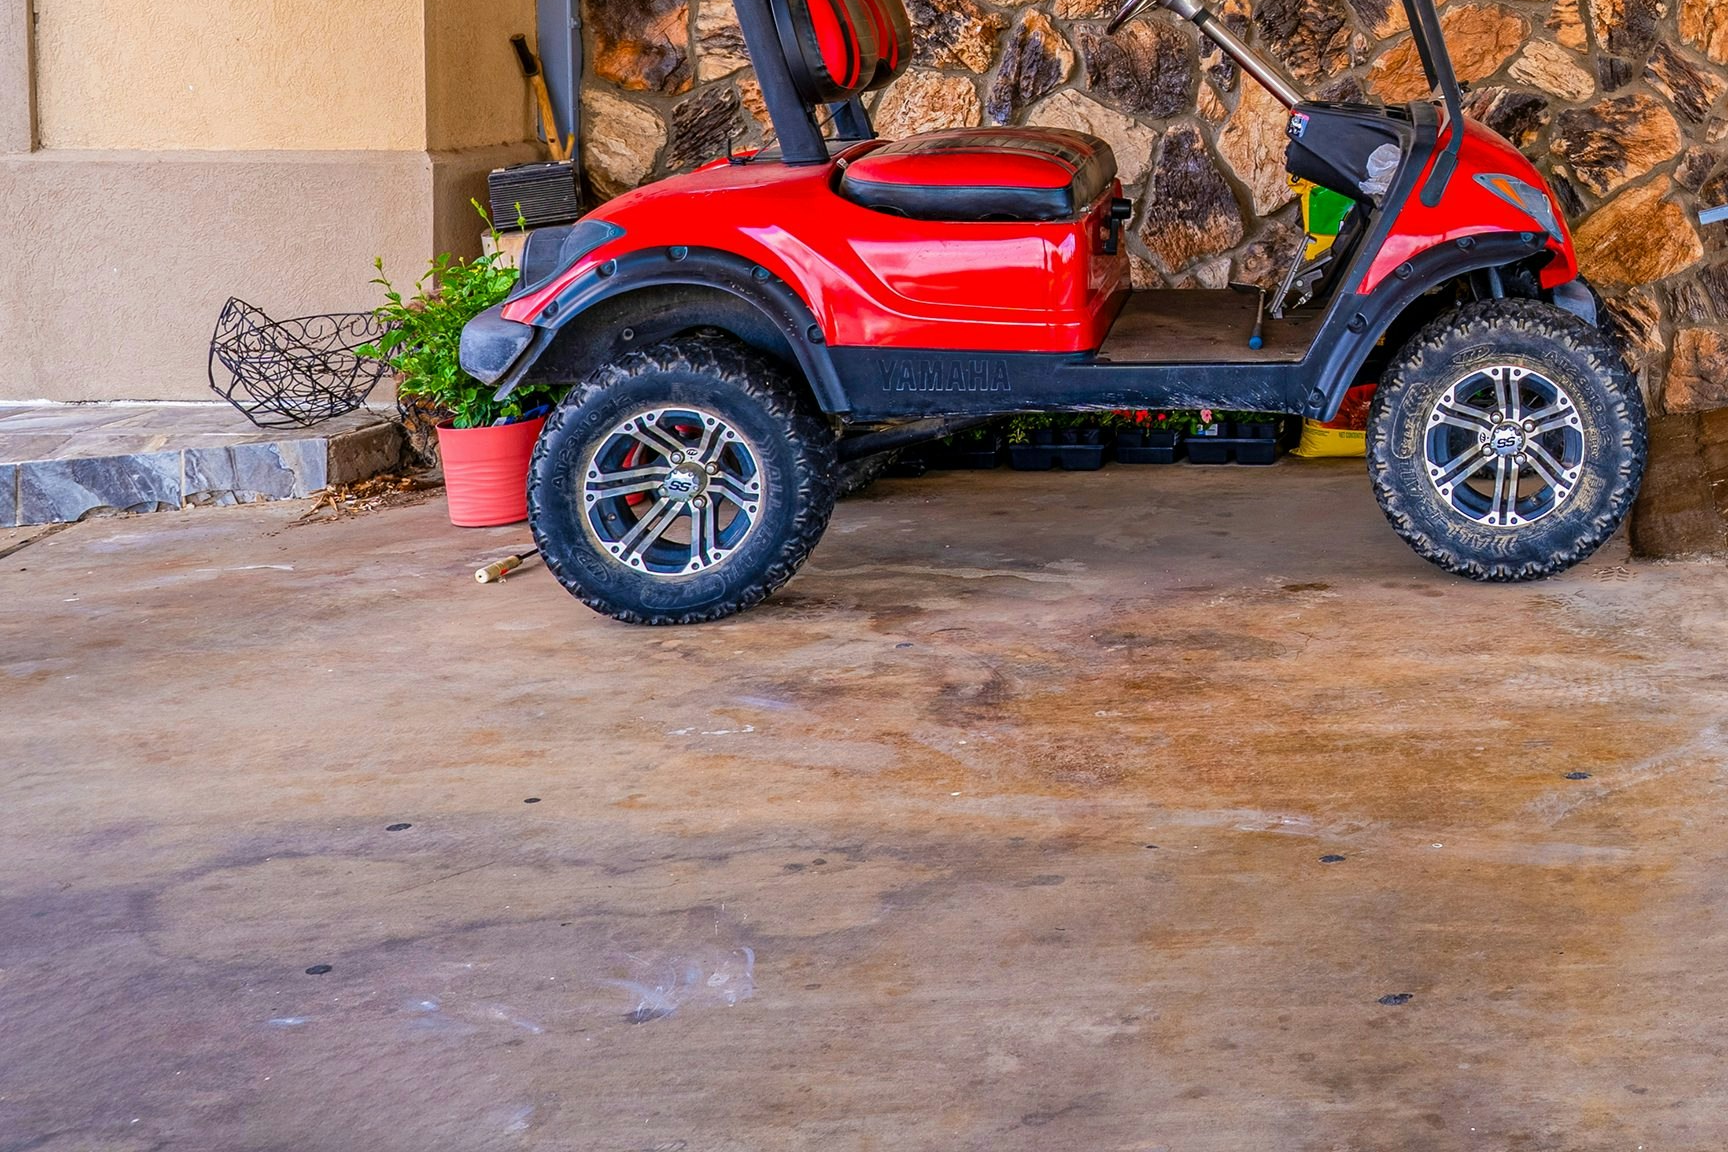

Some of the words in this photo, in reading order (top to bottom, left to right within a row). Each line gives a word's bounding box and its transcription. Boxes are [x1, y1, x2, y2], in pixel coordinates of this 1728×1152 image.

[877, 359, 1012, 391] YAMAHA
[1496, 436, 1516, 448] SS
[668, 480, 692, 492] SS
